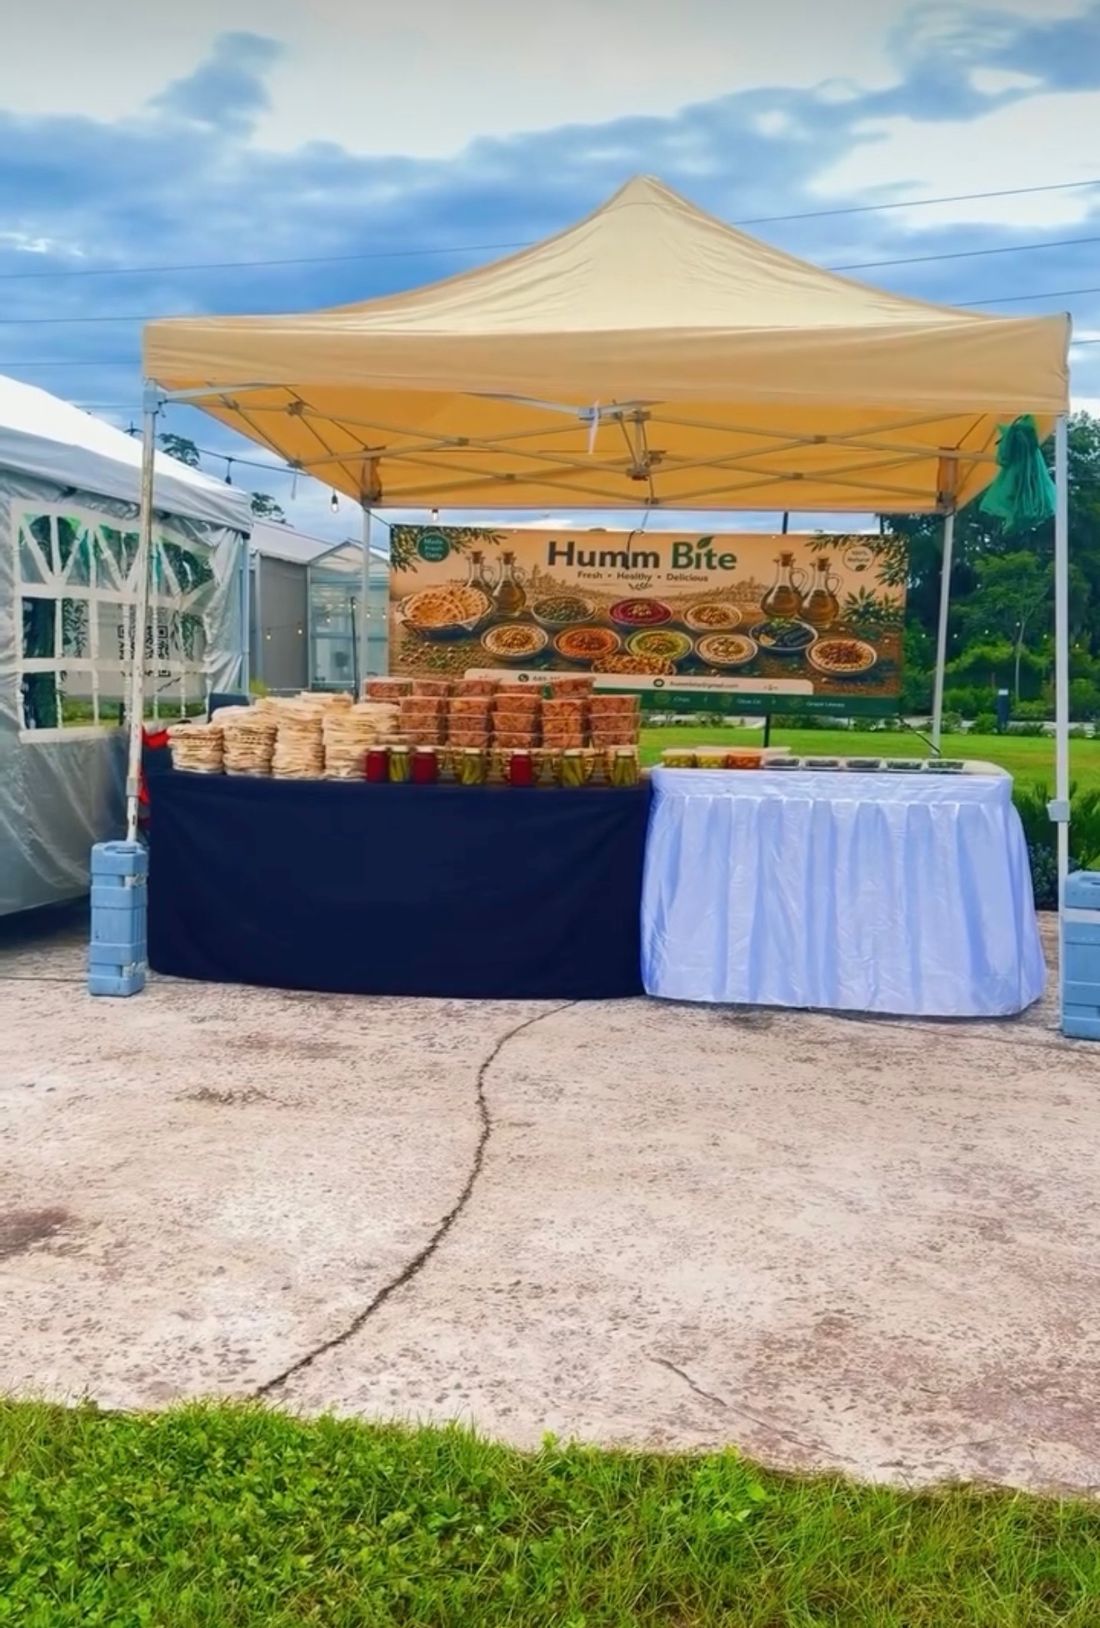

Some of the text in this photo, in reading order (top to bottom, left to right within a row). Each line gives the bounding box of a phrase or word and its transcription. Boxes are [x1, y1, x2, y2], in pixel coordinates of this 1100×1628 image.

[548, 536, 737, 570] Humm Bite
[577, 571, 709, 583] Fresh Healthy Delicious
